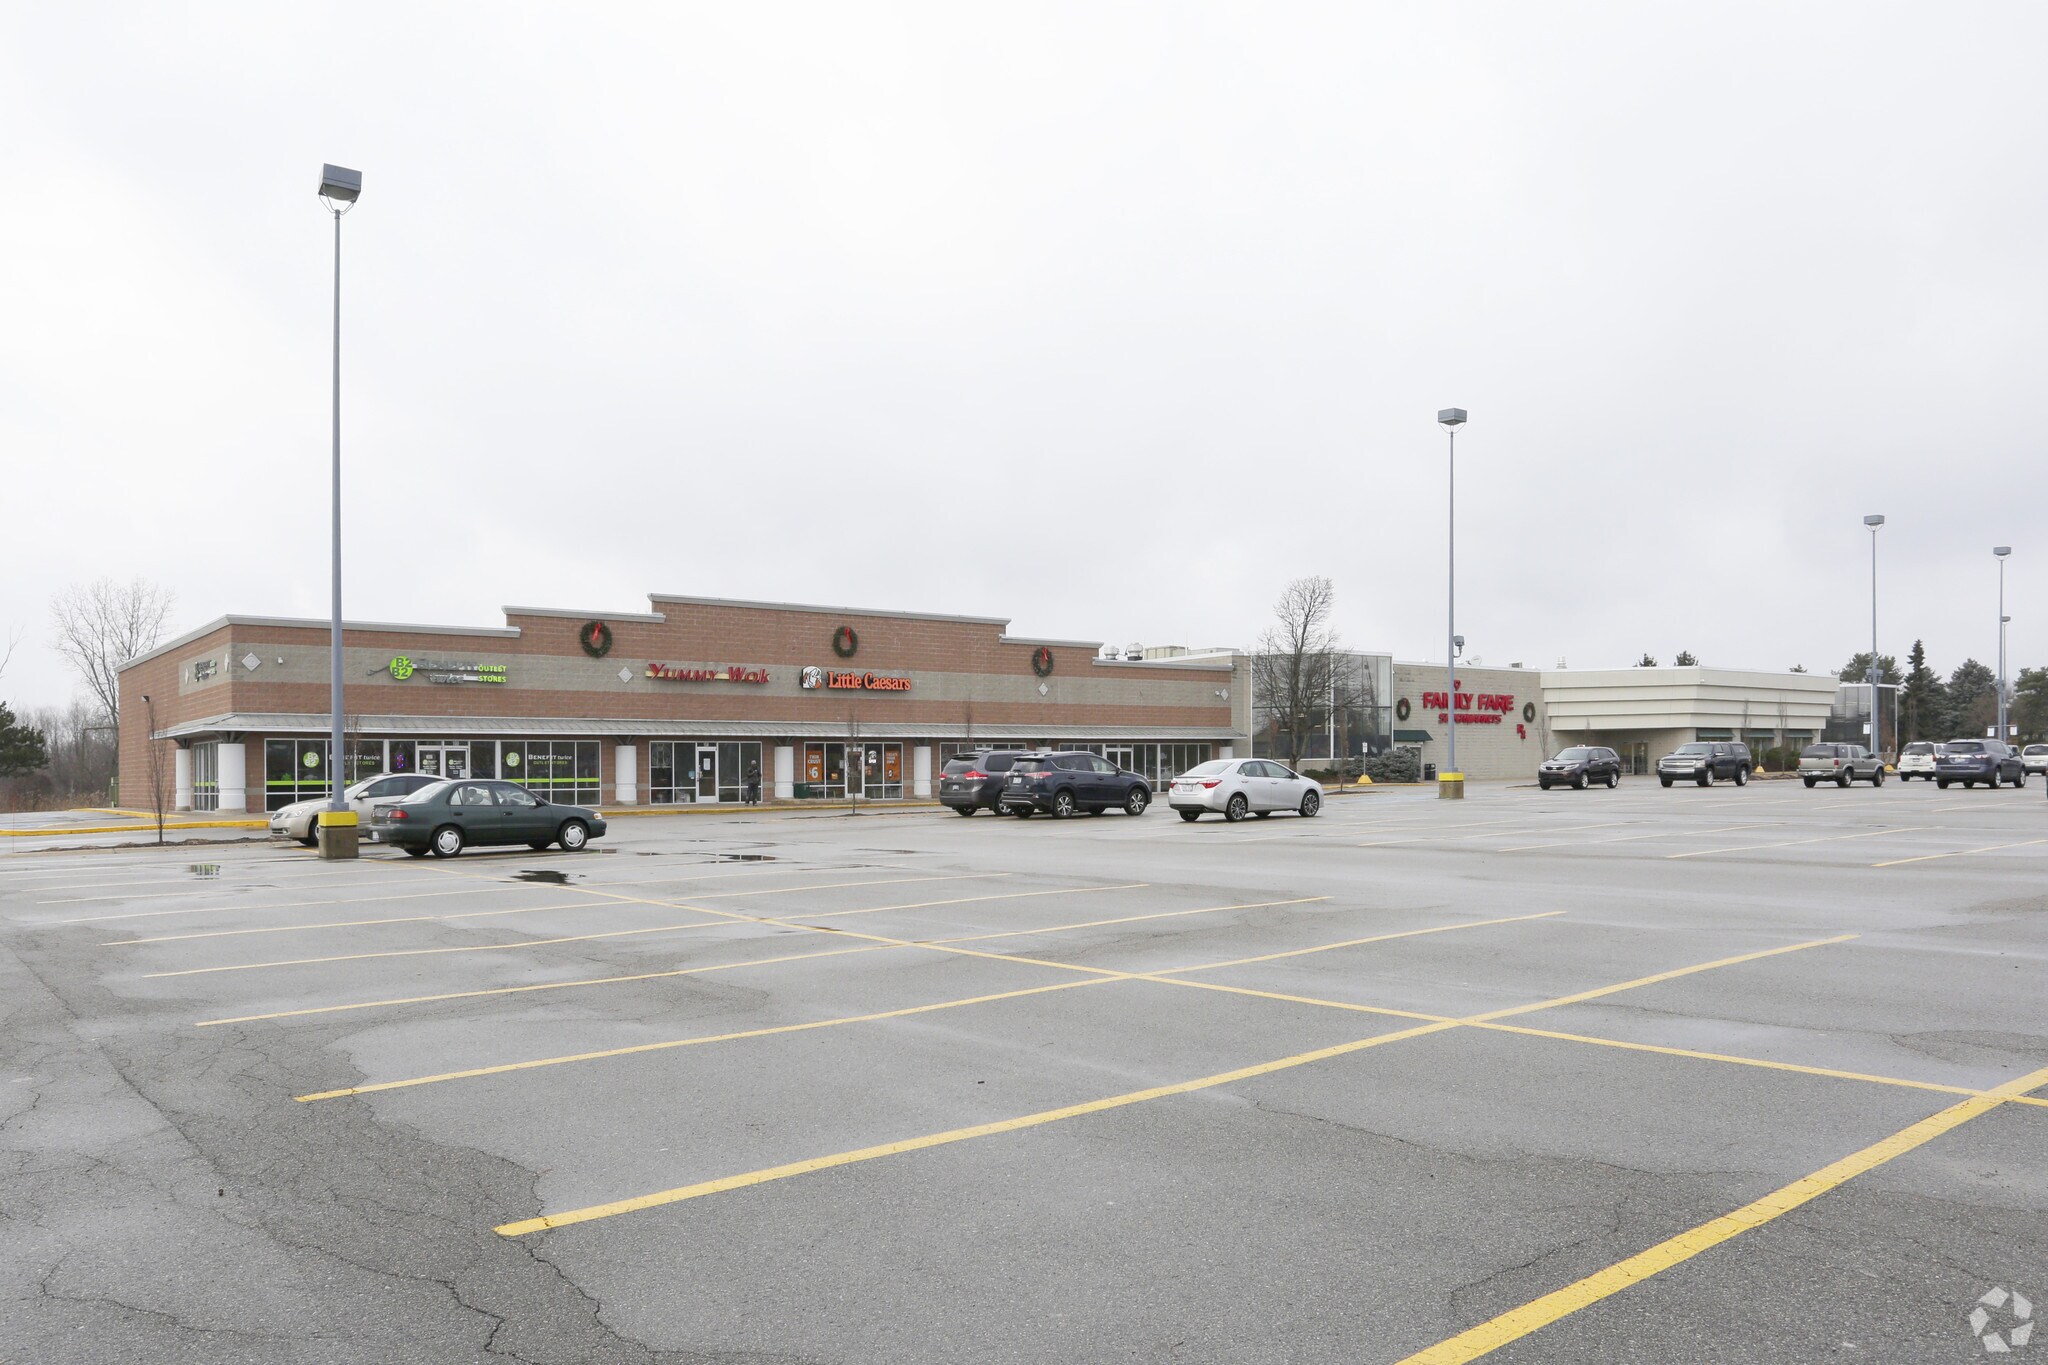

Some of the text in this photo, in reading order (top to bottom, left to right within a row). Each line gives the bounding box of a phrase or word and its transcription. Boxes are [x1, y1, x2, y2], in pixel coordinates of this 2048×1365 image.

[395, 657, 412, 668] B2
[478, 664, 507, 672] OUTLET
[391, 667, 408, 677] B2
[648, 663, 770, 684] YUMMY Wok
[478, 674, 507, 683] STORES
[827, 671, 912, 690] Little Caesars
[1477, 693, 1515, 715] FARE
